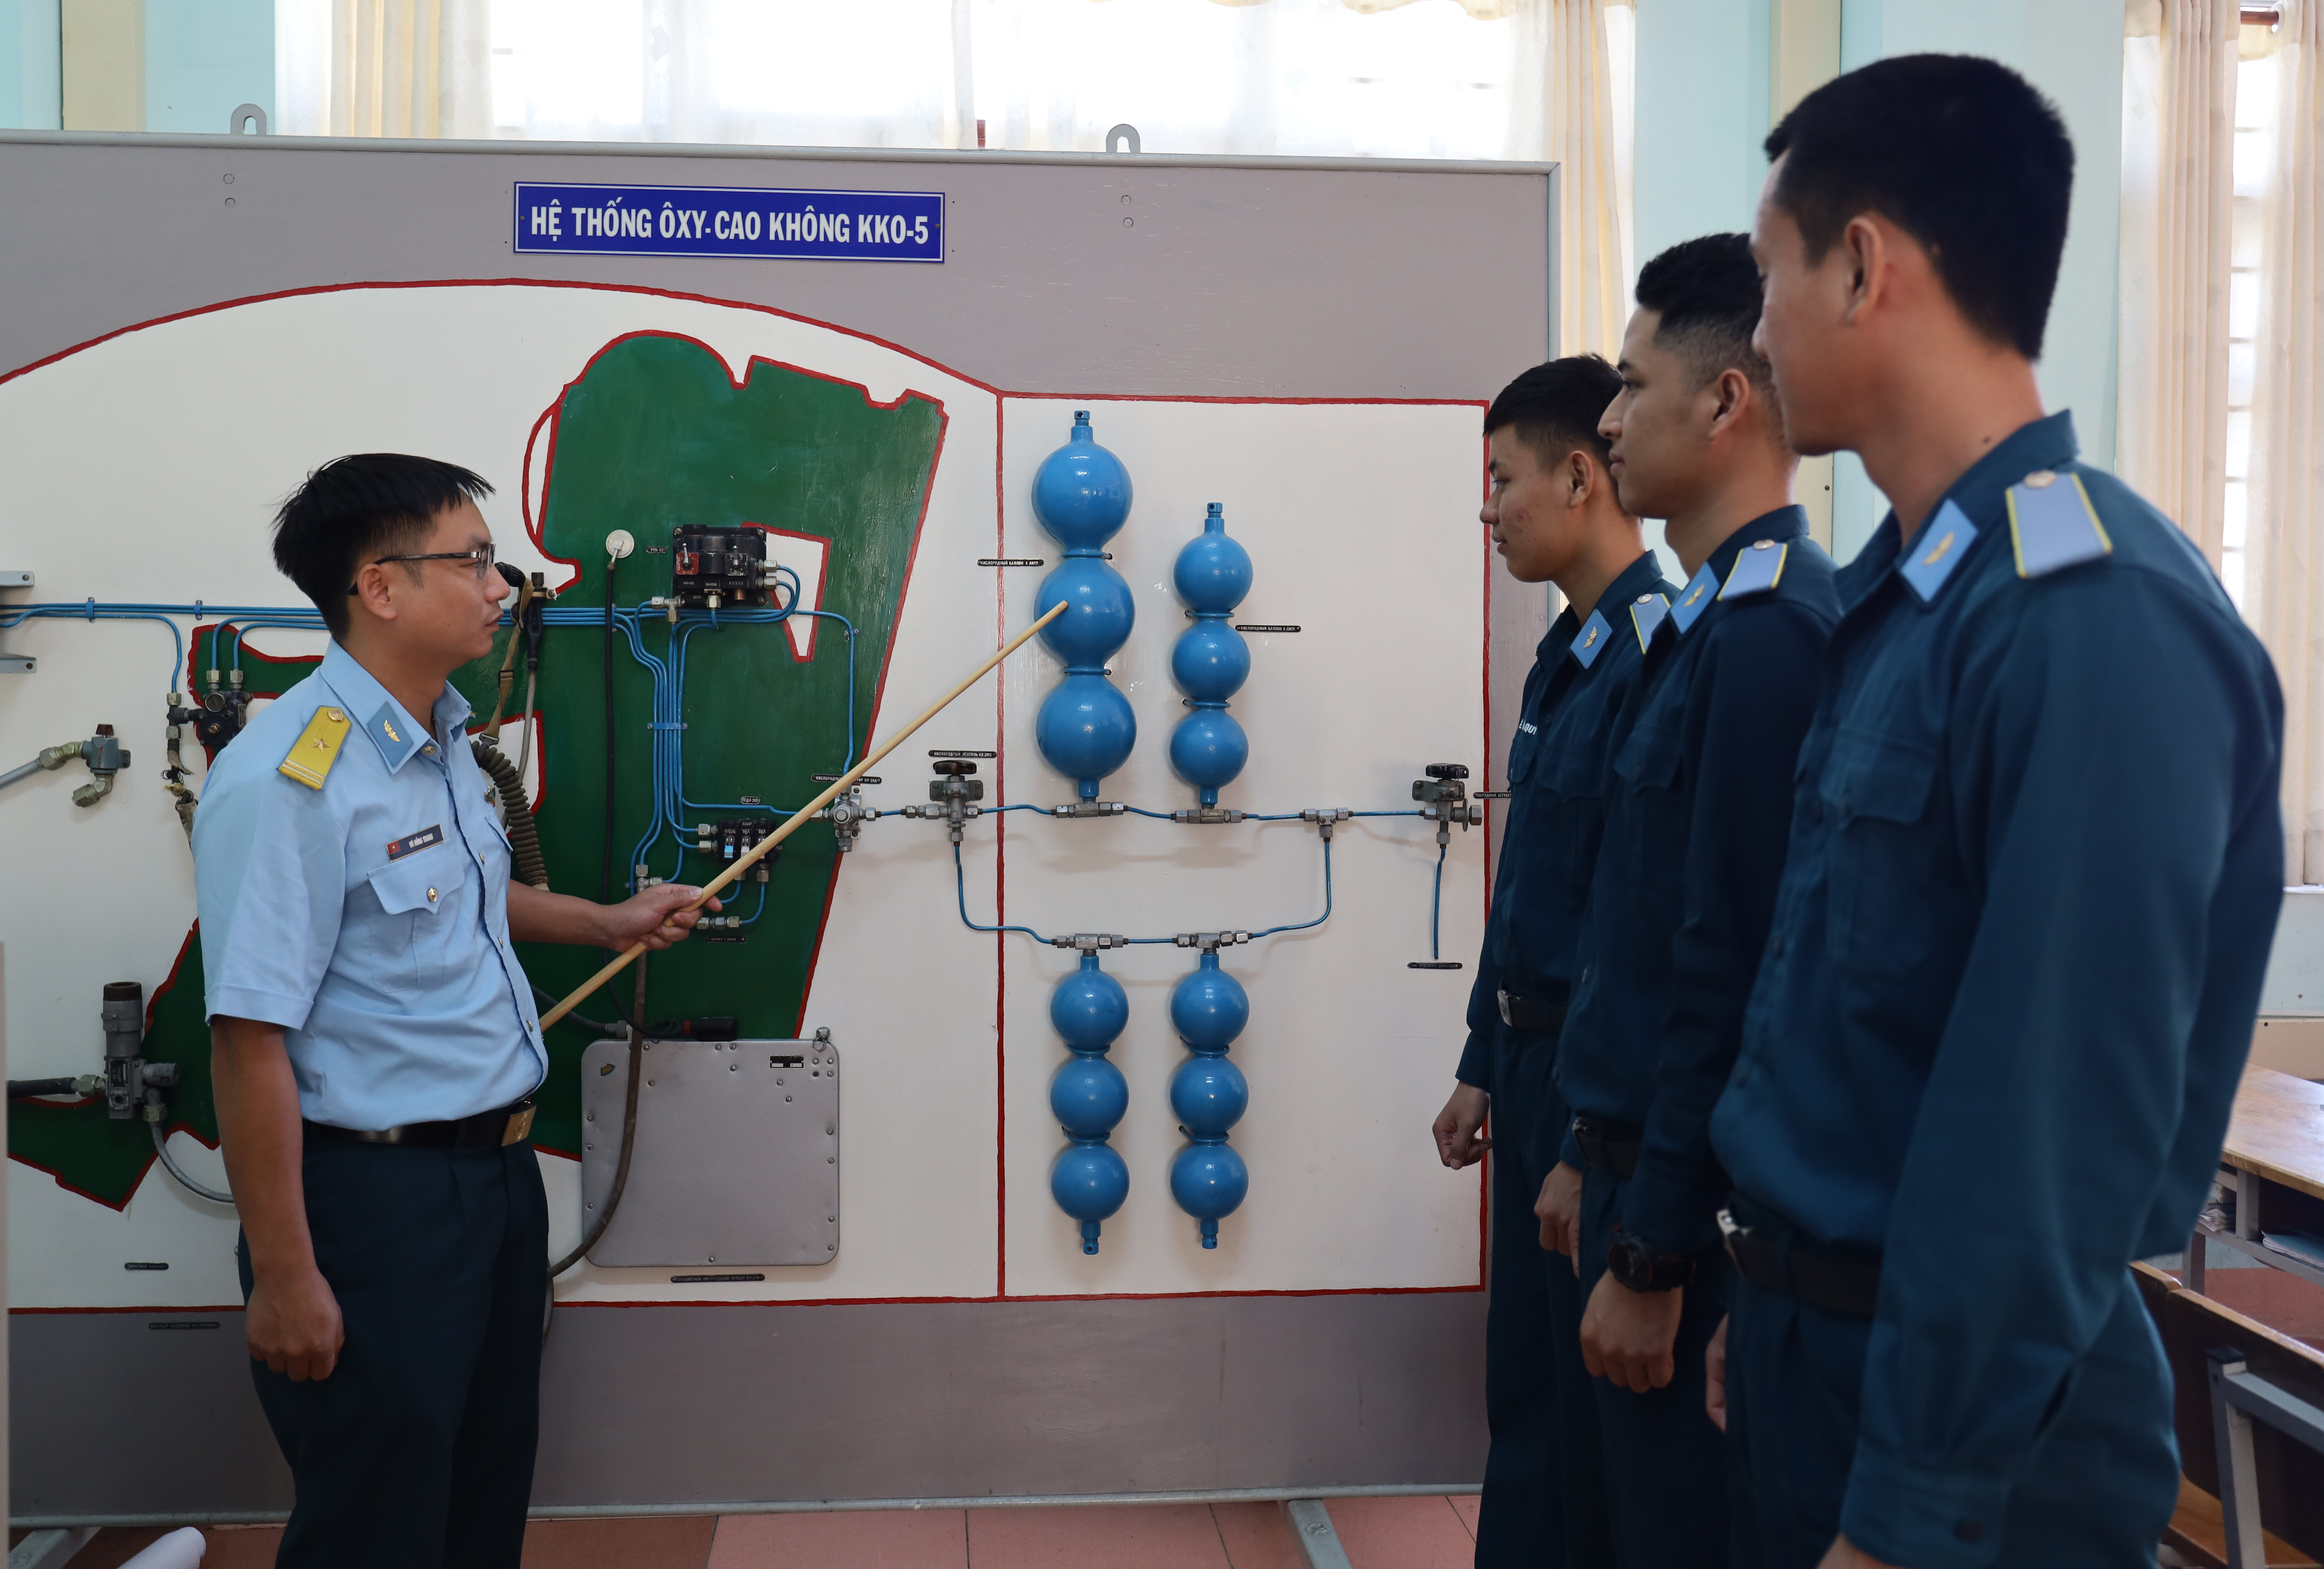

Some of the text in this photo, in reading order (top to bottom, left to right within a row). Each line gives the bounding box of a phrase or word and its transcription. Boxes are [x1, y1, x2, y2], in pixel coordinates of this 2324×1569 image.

[531, 199, 562, 242] HỆ
[572, 197, 652, 238] THỐNG
[769, 205, 851, 243] KHÔNG
[858, 214, 929, 244] KKO-5
